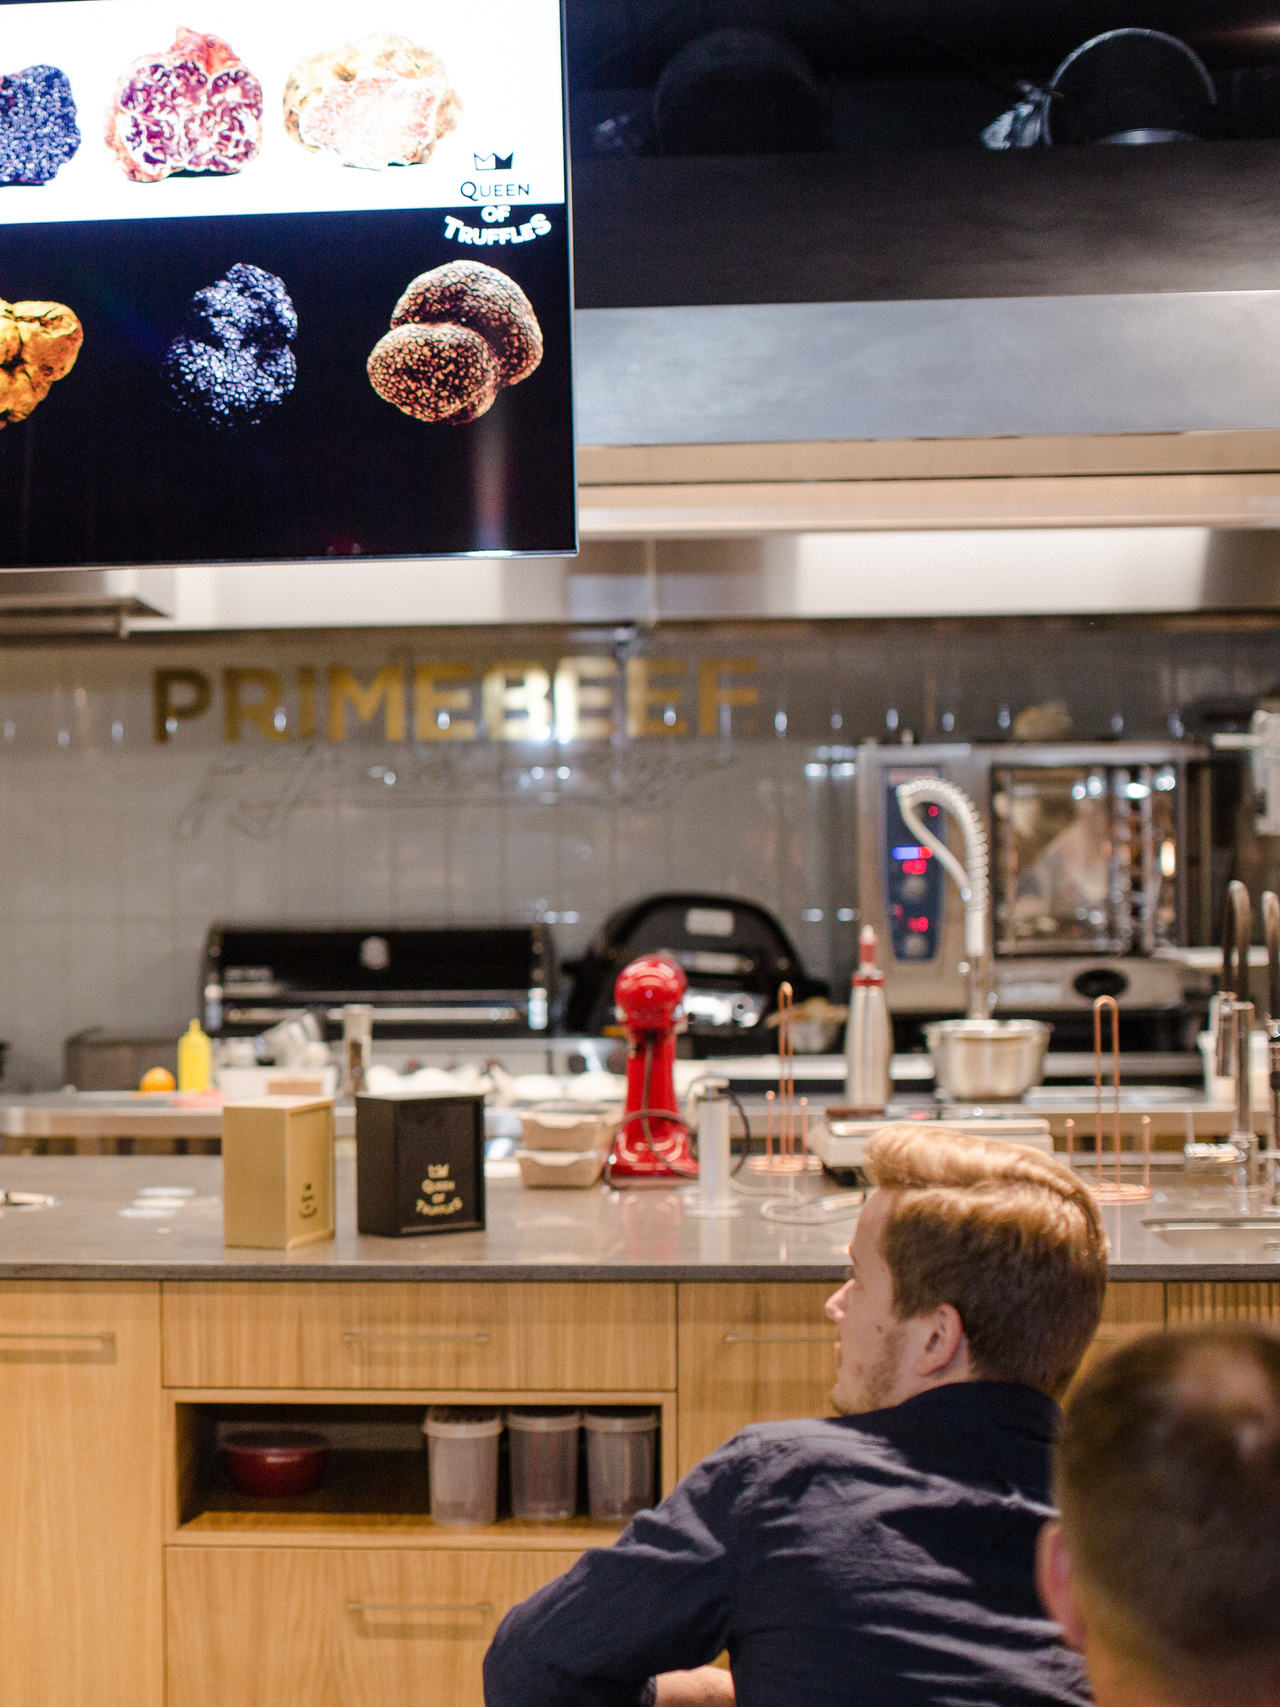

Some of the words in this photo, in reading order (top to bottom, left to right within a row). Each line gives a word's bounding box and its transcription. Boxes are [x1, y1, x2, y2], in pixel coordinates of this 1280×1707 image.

[460, 181, 530, 202] QUEEN
[480, 205, 511, 223] OF
[444, 213, 552, 246] TRUFFLES
[153, 655, 759, 744] PRIMEBEEF
